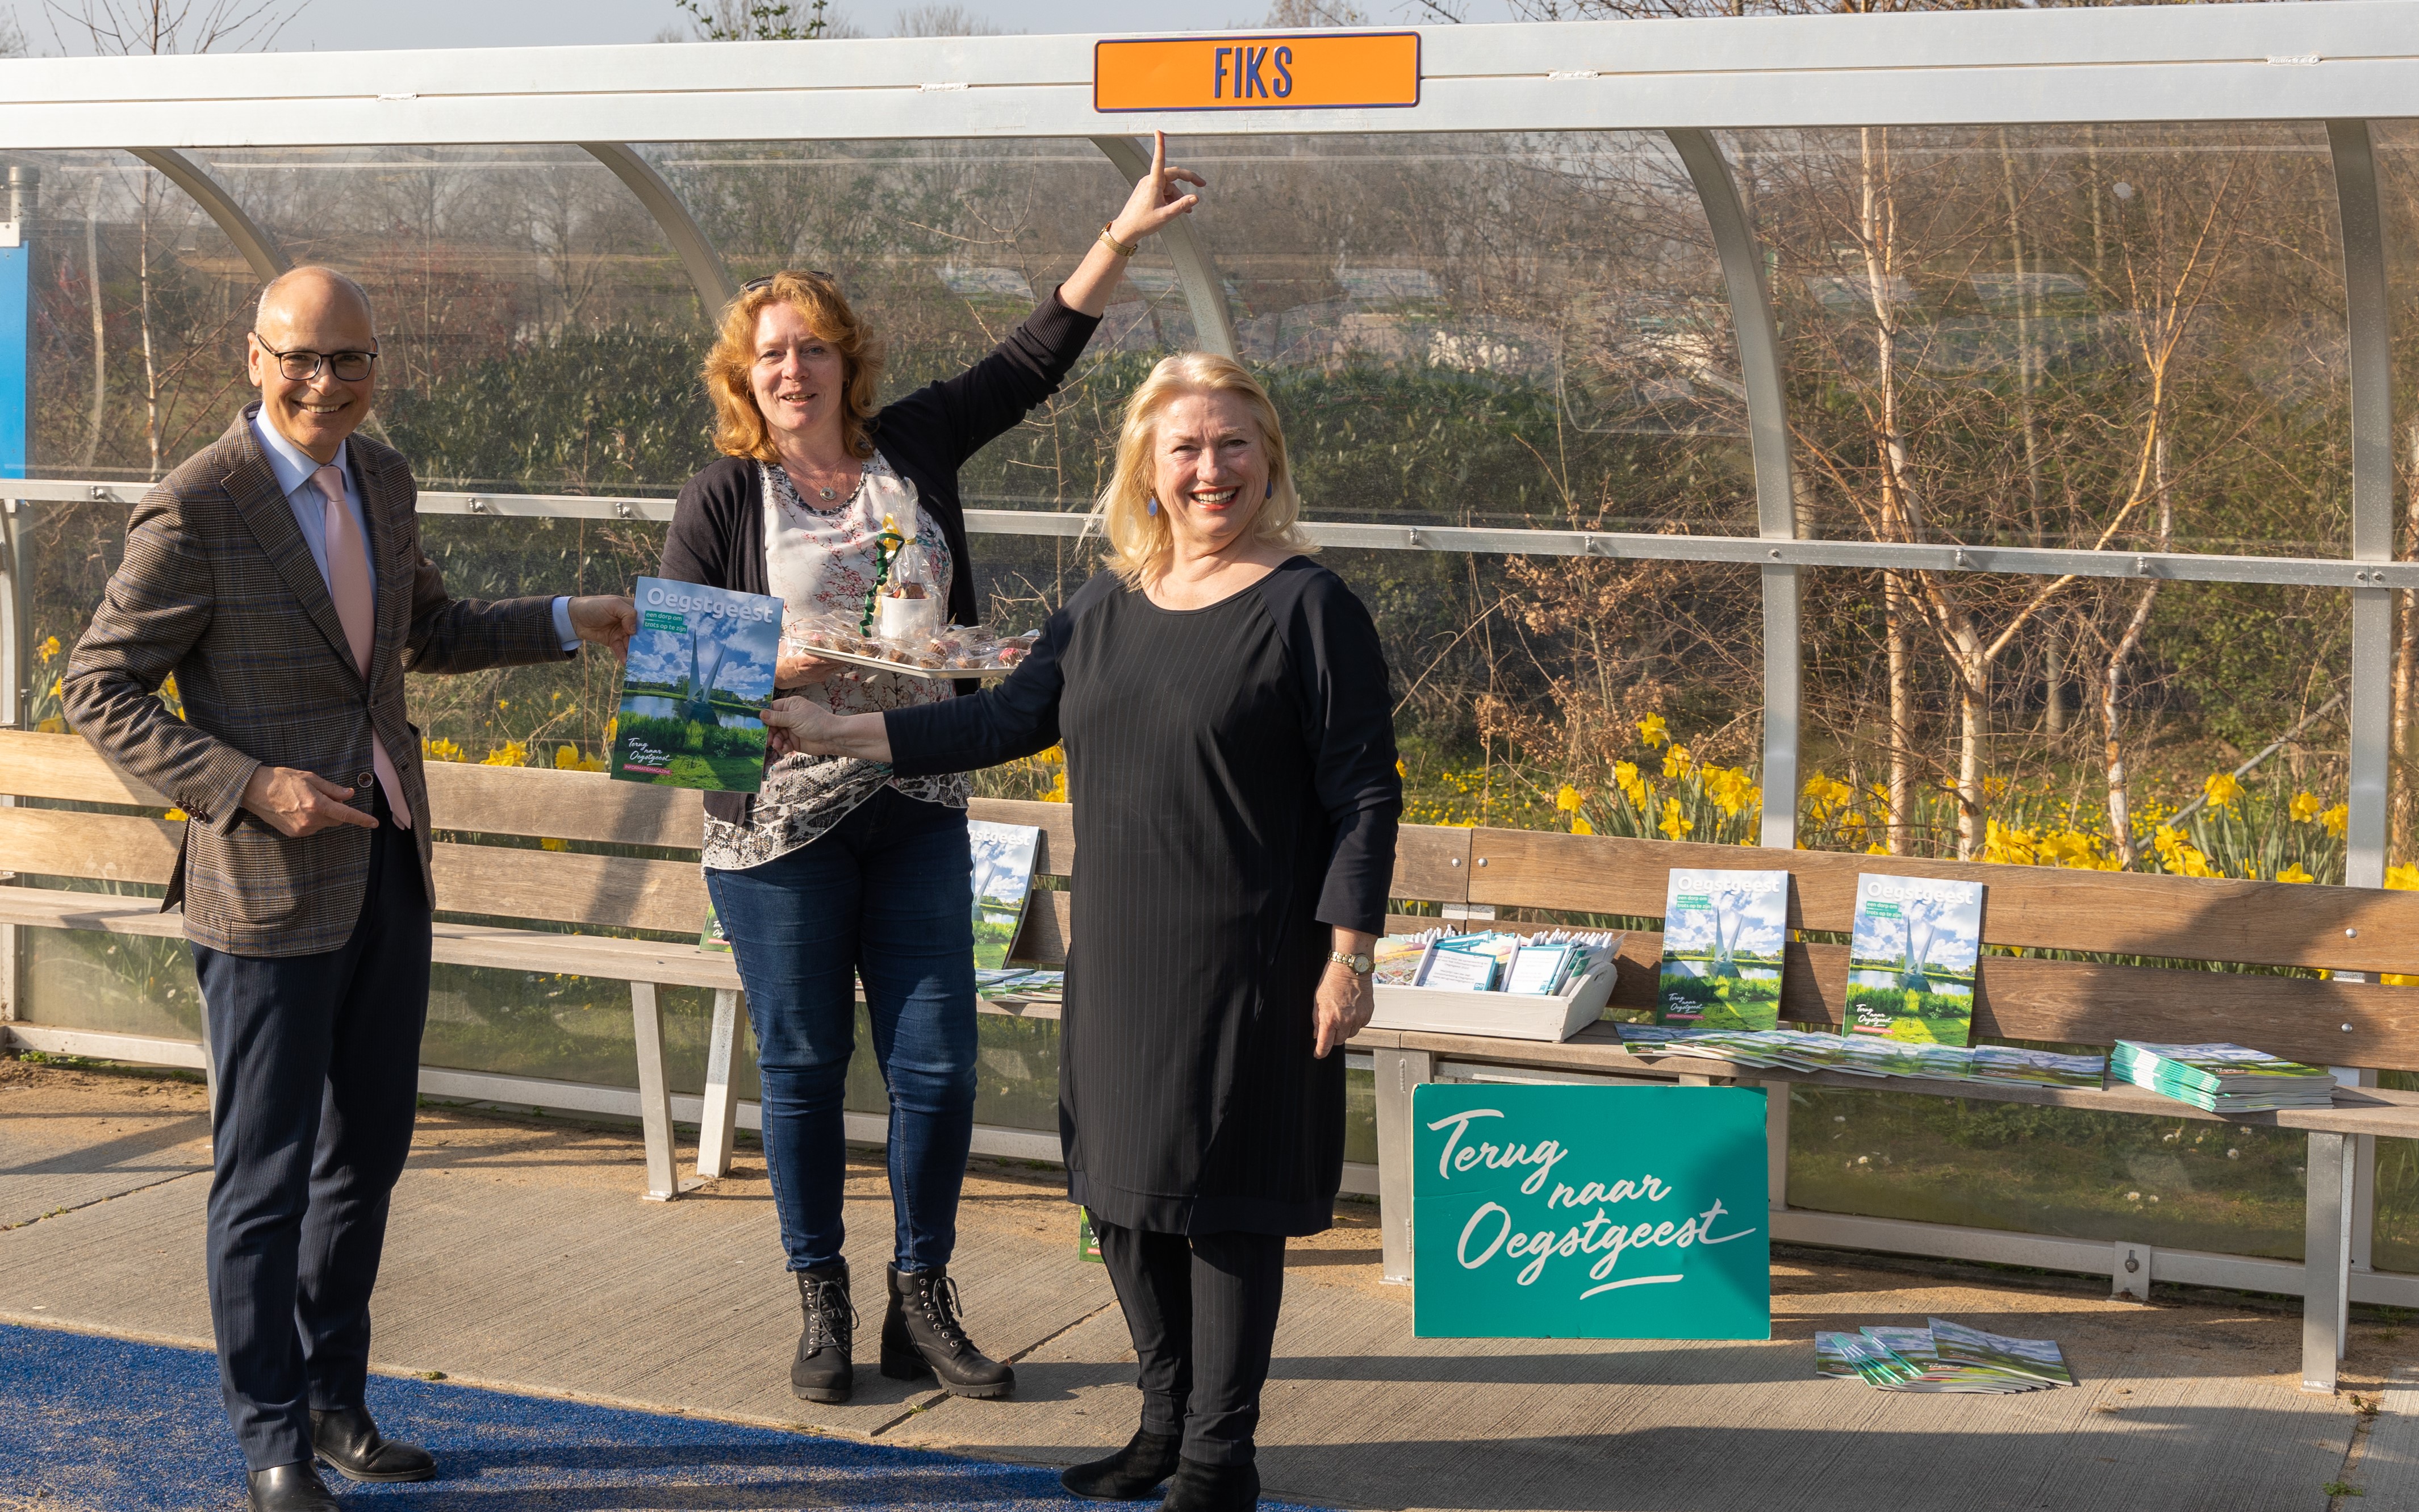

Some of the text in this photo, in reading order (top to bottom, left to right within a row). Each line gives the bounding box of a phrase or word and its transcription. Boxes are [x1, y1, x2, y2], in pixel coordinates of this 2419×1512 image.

[1214, 46, 1293, 98] FIKS
[647, 587, 774, 623] Oegstgeest
[658, 613, 671, 621] dorp
[628, 737, 649, 750] Terug
[629, 750, 674, 763] Oegstgeest
[625, 765, 671, 774] INFORMATIEMAGAZINE
[970, 828, 1030, 846] gstgeest
[1678, 876, 1779, 895] Oegstgeest
[1867, 882, 1974, 905] Oegstgeest
[1427, 1109, 1568, 1194] Terug
[1547, 1174, 1672, 1209] naar
[1456, 1198, 1757, 1286] Oegstgeest
